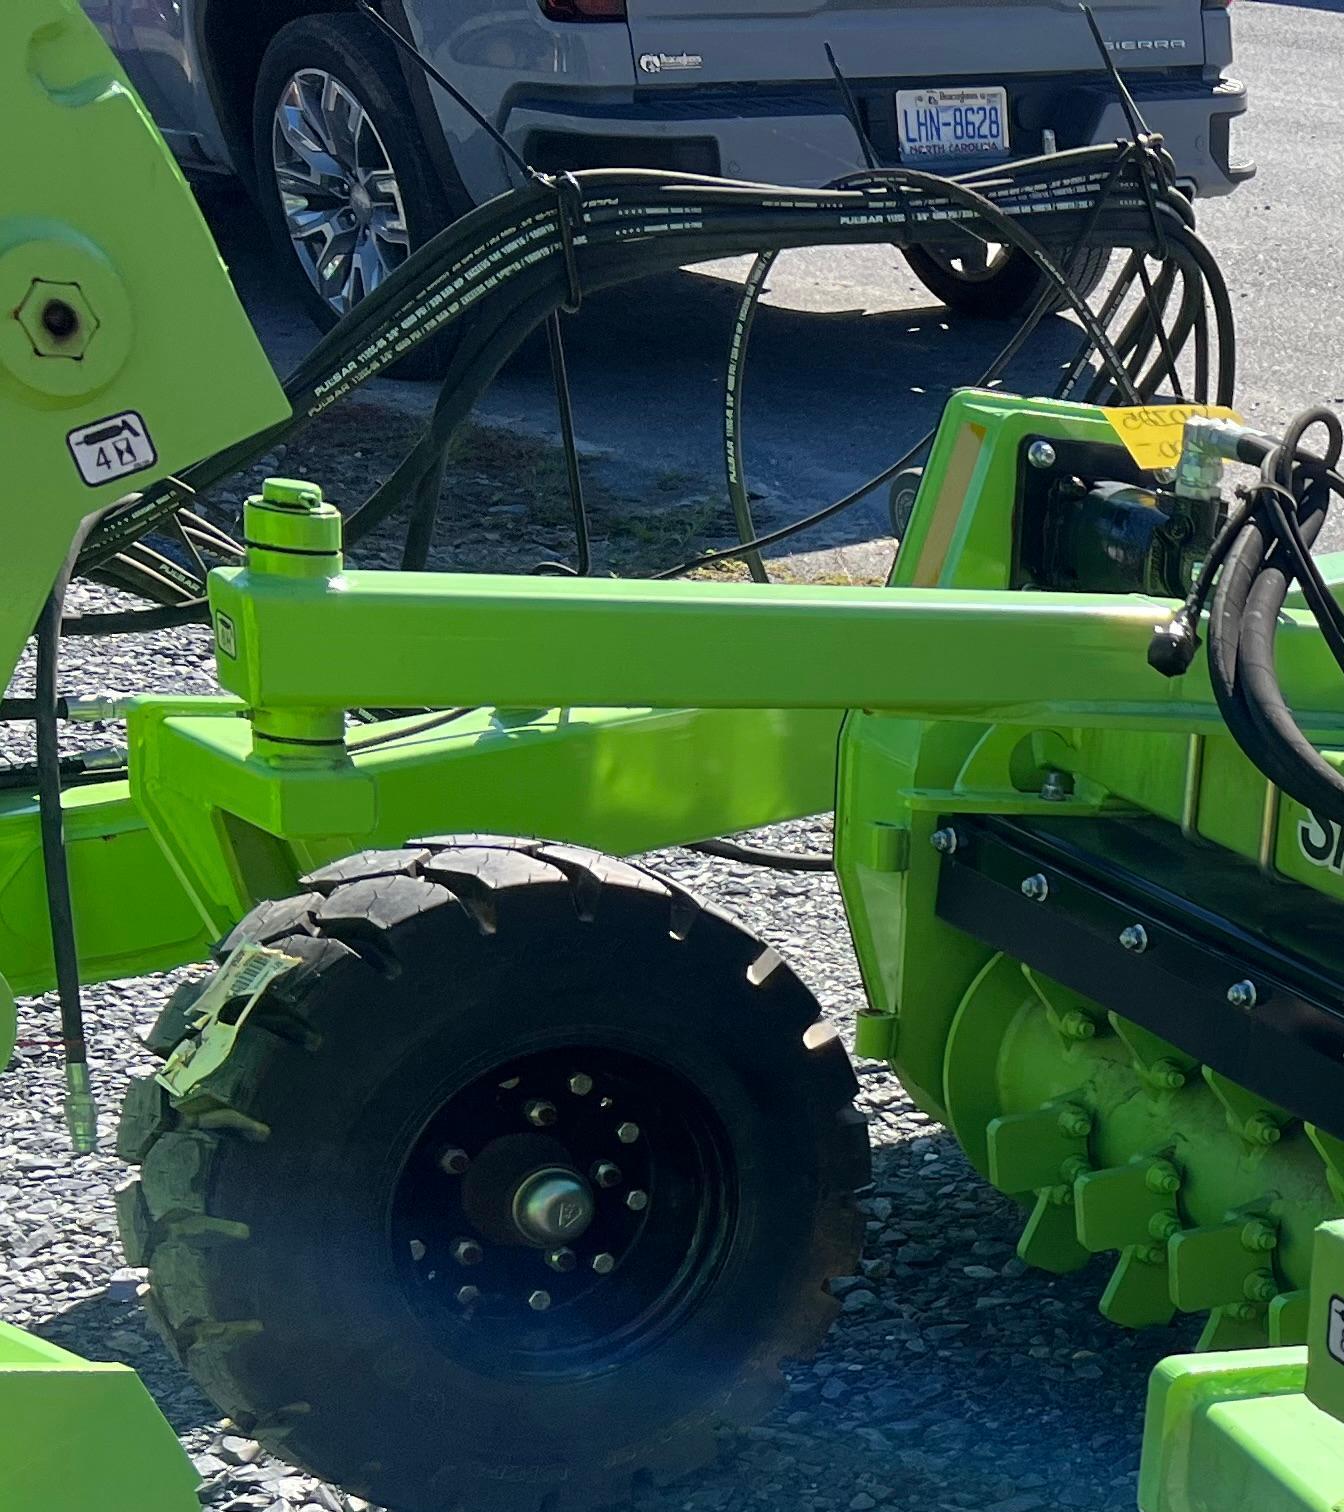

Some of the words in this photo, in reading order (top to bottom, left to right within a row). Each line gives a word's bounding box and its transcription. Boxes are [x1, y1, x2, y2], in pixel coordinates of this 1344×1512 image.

[1103, 39, 1186, 51] SIERRA
[903, 106, 1000, 142] LHN-8628
[314, 361, 358, 397] PULSAR
[95, 446, 112, 471] 4
[159, 563, 202, 592] PULSAR
